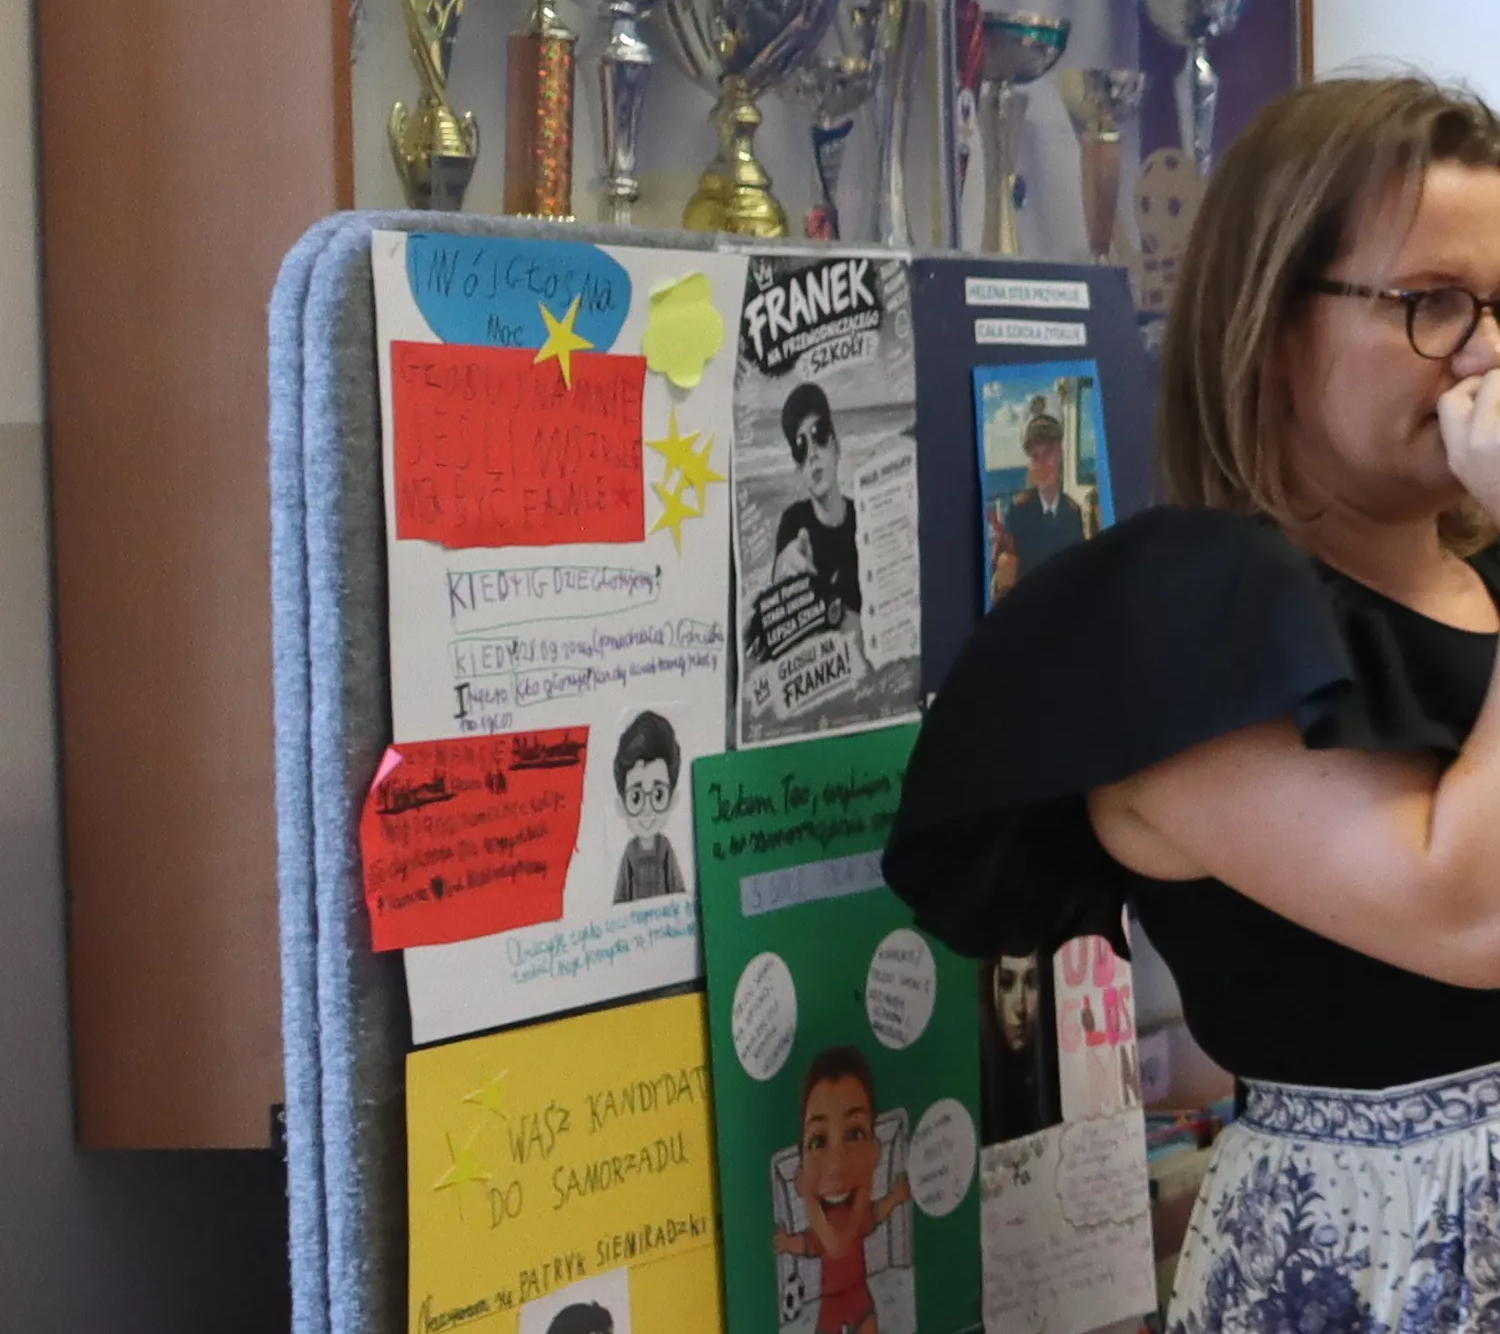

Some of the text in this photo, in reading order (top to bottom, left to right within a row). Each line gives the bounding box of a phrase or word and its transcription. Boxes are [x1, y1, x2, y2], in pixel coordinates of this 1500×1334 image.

[744, 258, 874, 360] FRANEK
[783, 642, 852, 707] FRANKA!
[586, 1066, 711, 1133] KANDYDAT
[489, 1181, 522, 1229] DO
